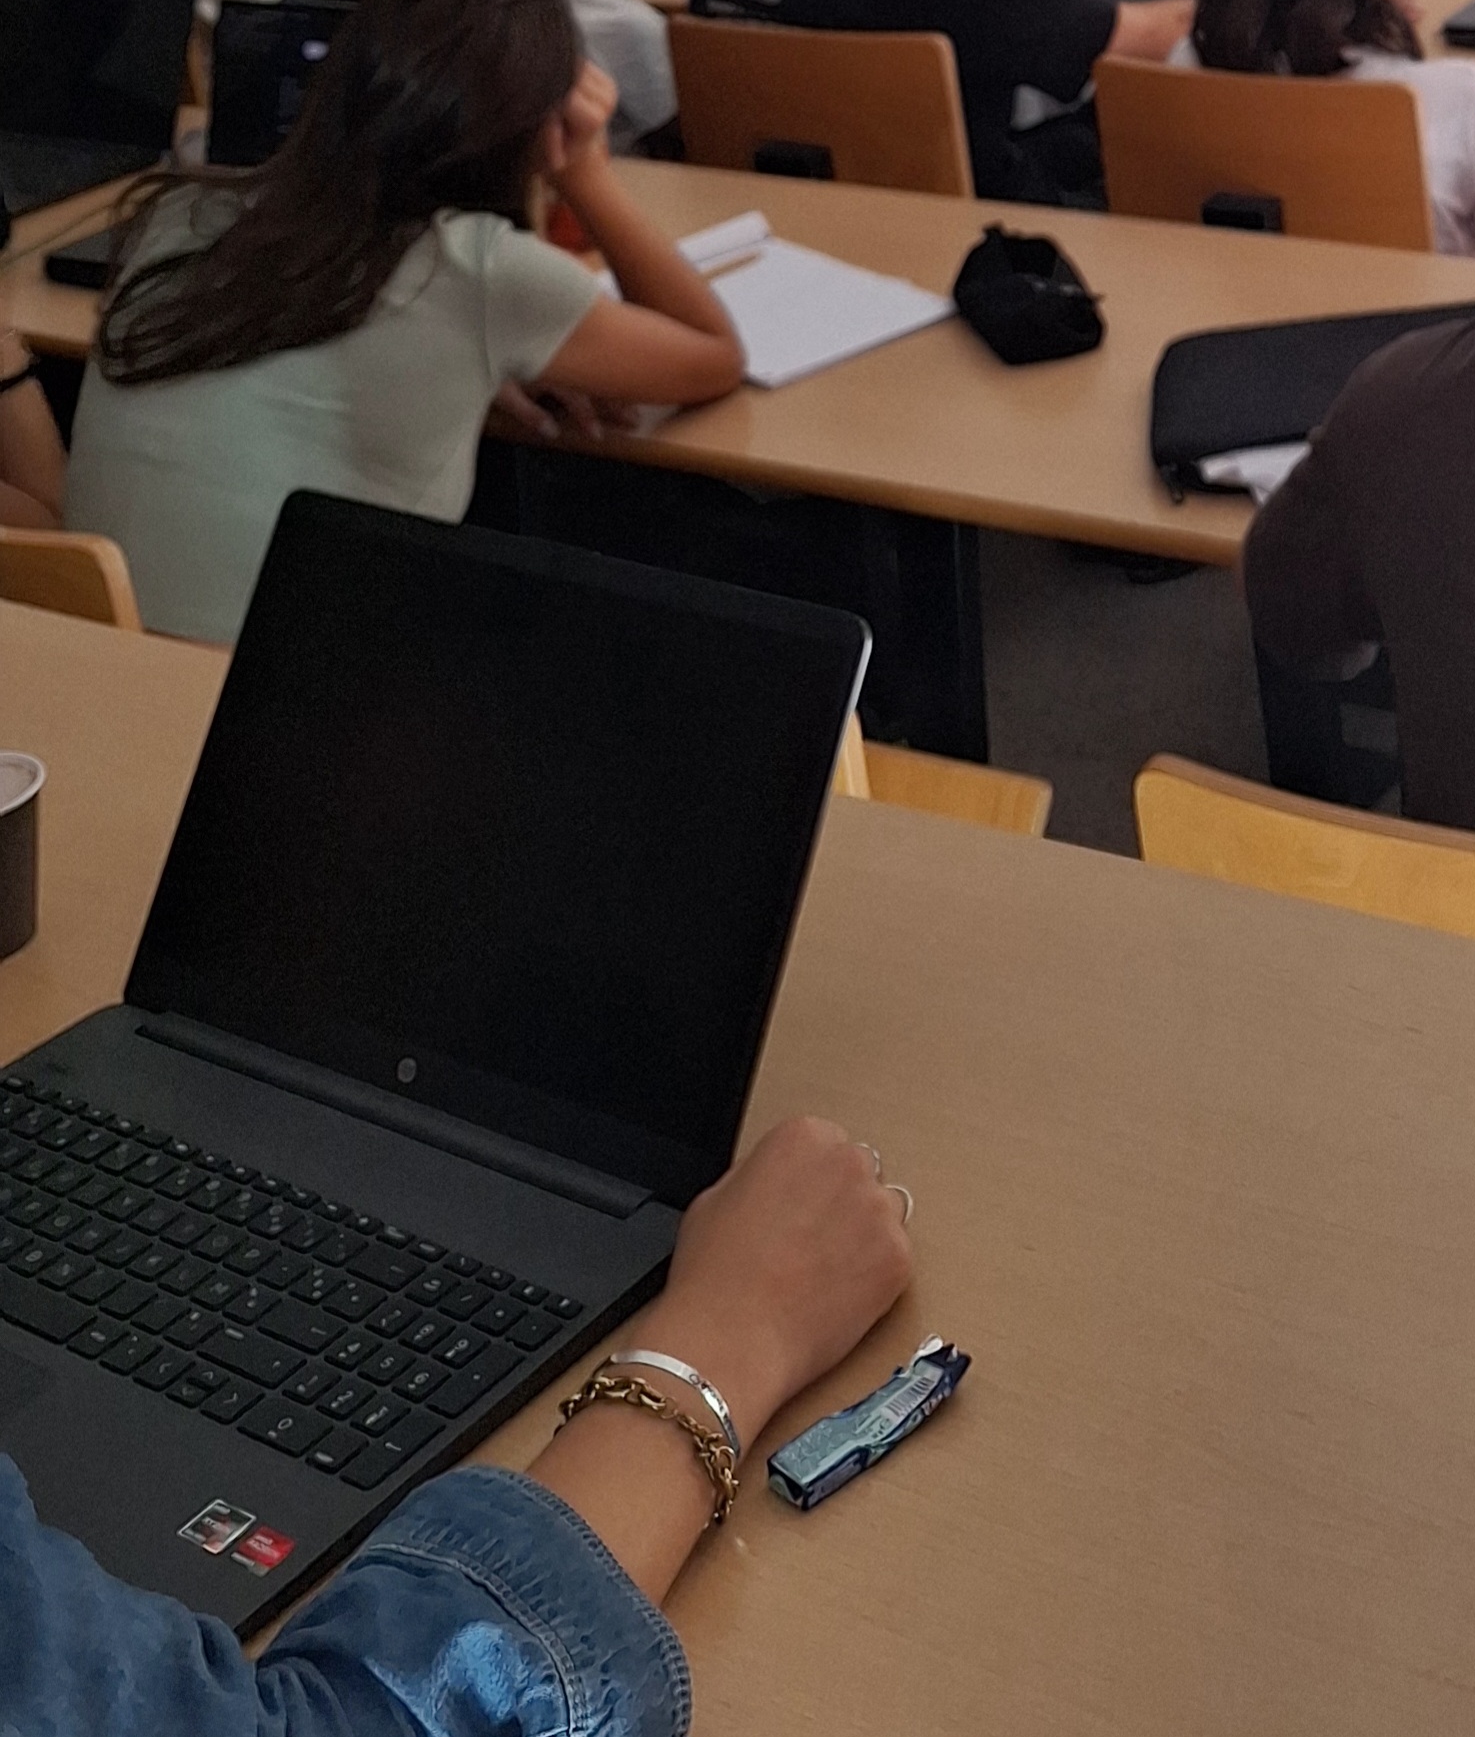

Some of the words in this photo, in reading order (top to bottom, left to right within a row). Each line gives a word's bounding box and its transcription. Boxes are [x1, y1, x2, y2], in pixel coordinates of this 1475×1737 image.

[455, 1338, 470, 1351] 9
[379, 1356, 395, 1369] 5
[415, 1371, 430, 1385] 6
[277, 1417, 293, 1430] 0
